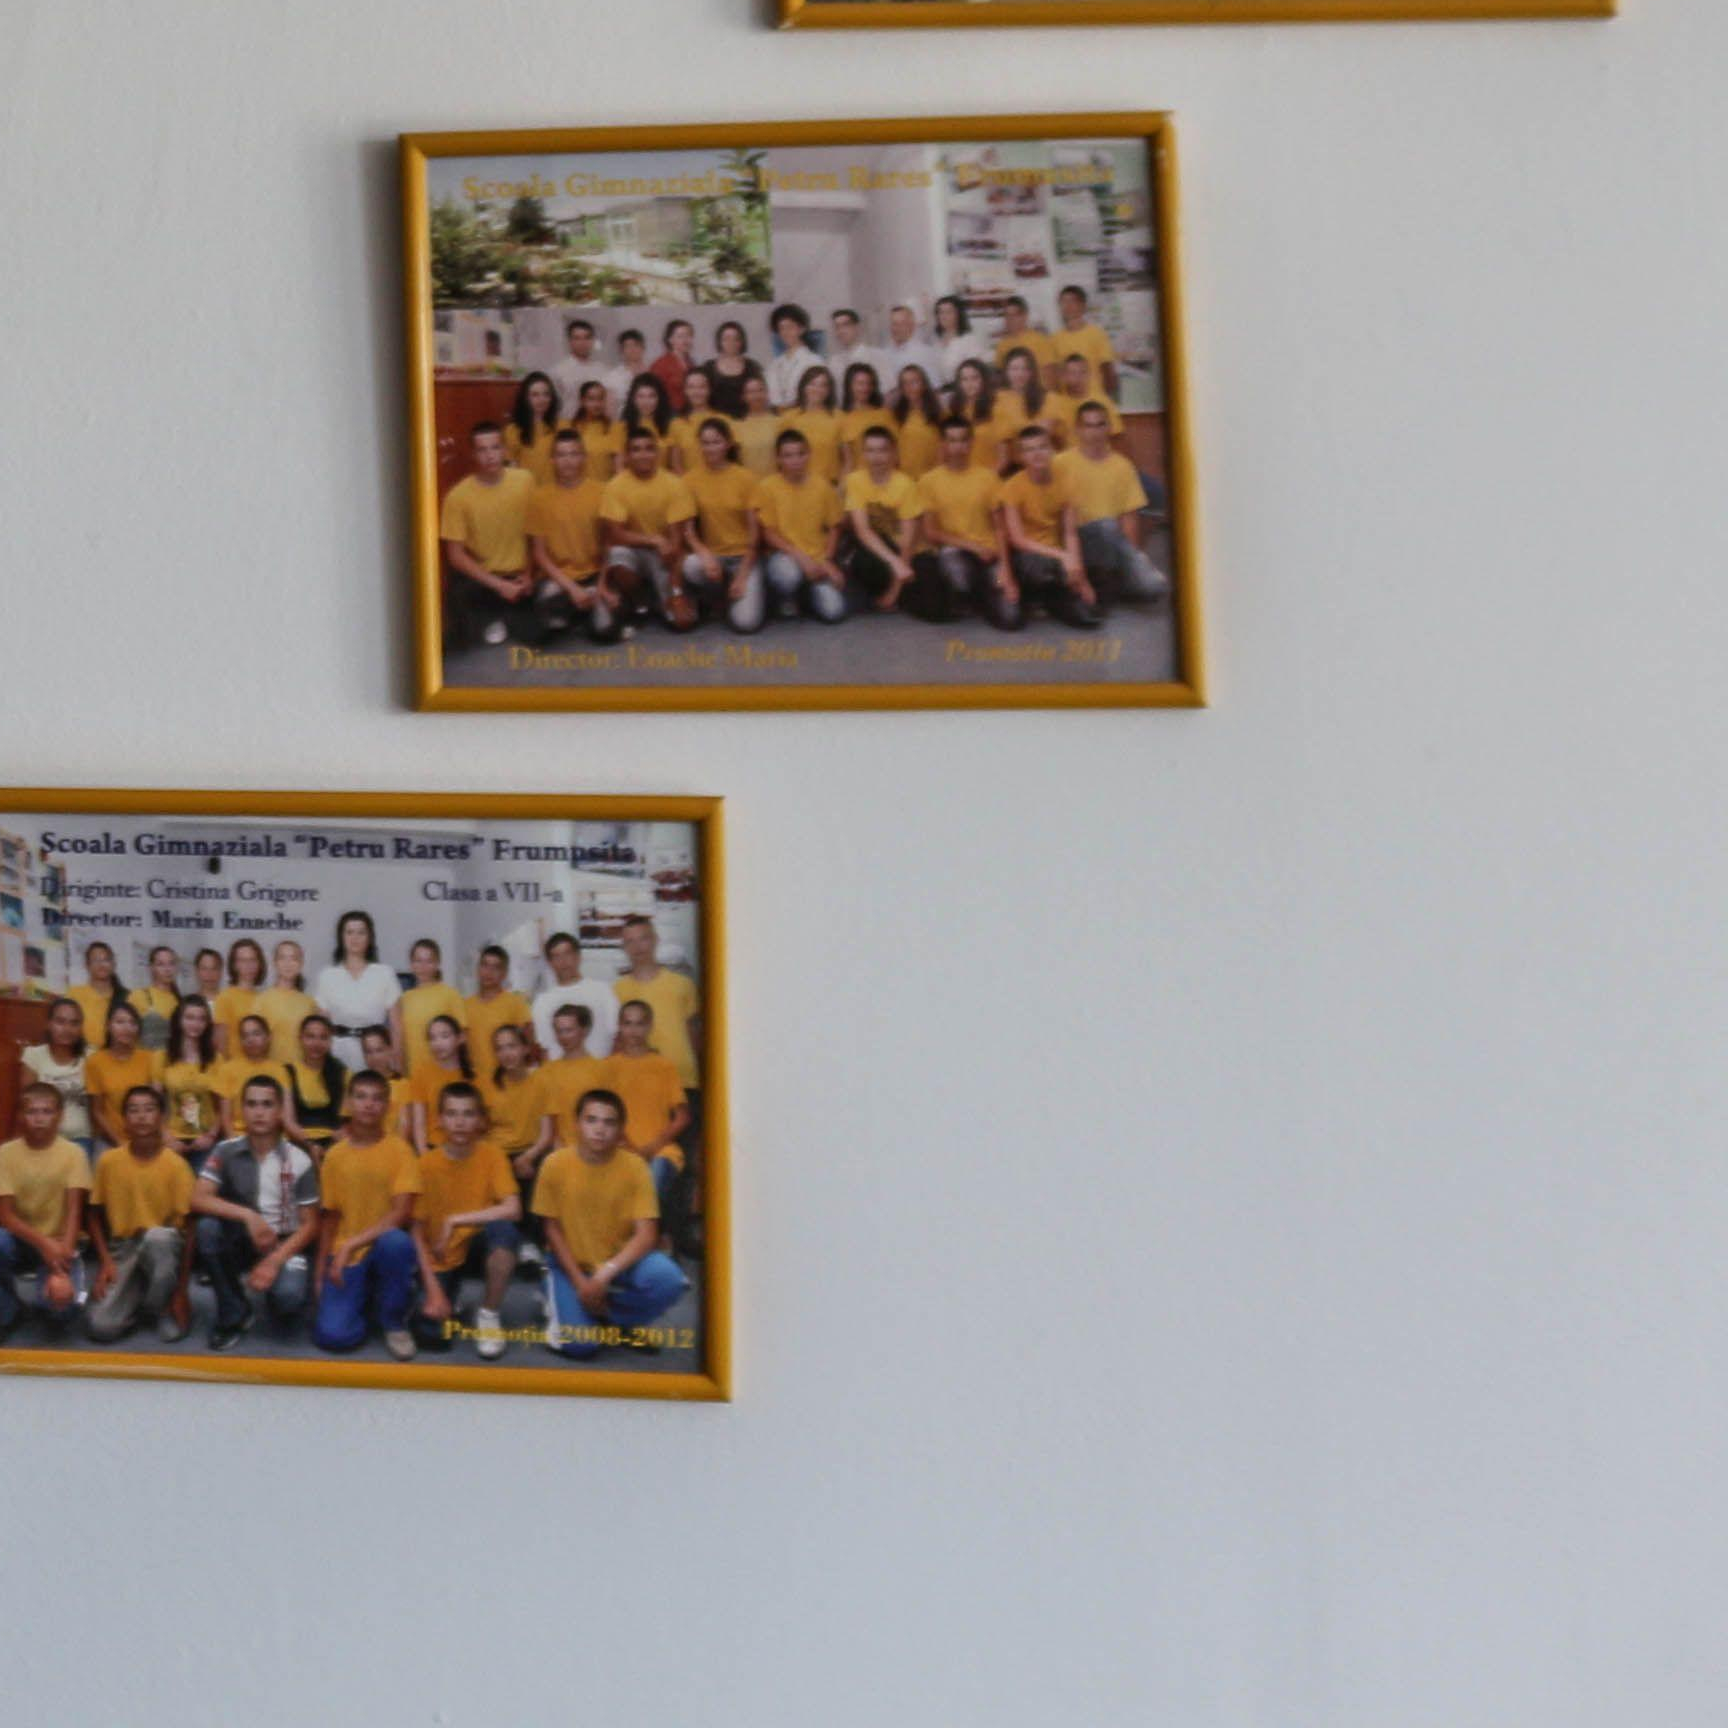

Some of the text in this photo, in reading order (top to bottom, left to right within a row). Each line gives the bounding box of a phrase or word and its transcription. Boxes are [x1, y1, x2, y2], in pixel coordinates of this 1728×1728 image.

[40, 831, 126, 855] Scoala
[133, 832, 288, 858] Gimnaziala
[294, 834, 385, 860] “Petru
[393, 836, 484, 861] Rares”
[147, 879, 230, 901] Cristina
[236, 879, 320, 907] Grigore
[422, 880, 481, 902] Clasa
[152, 909, 214, 929] Maria
[558, 1324, 694, 1349] 2008-2012
